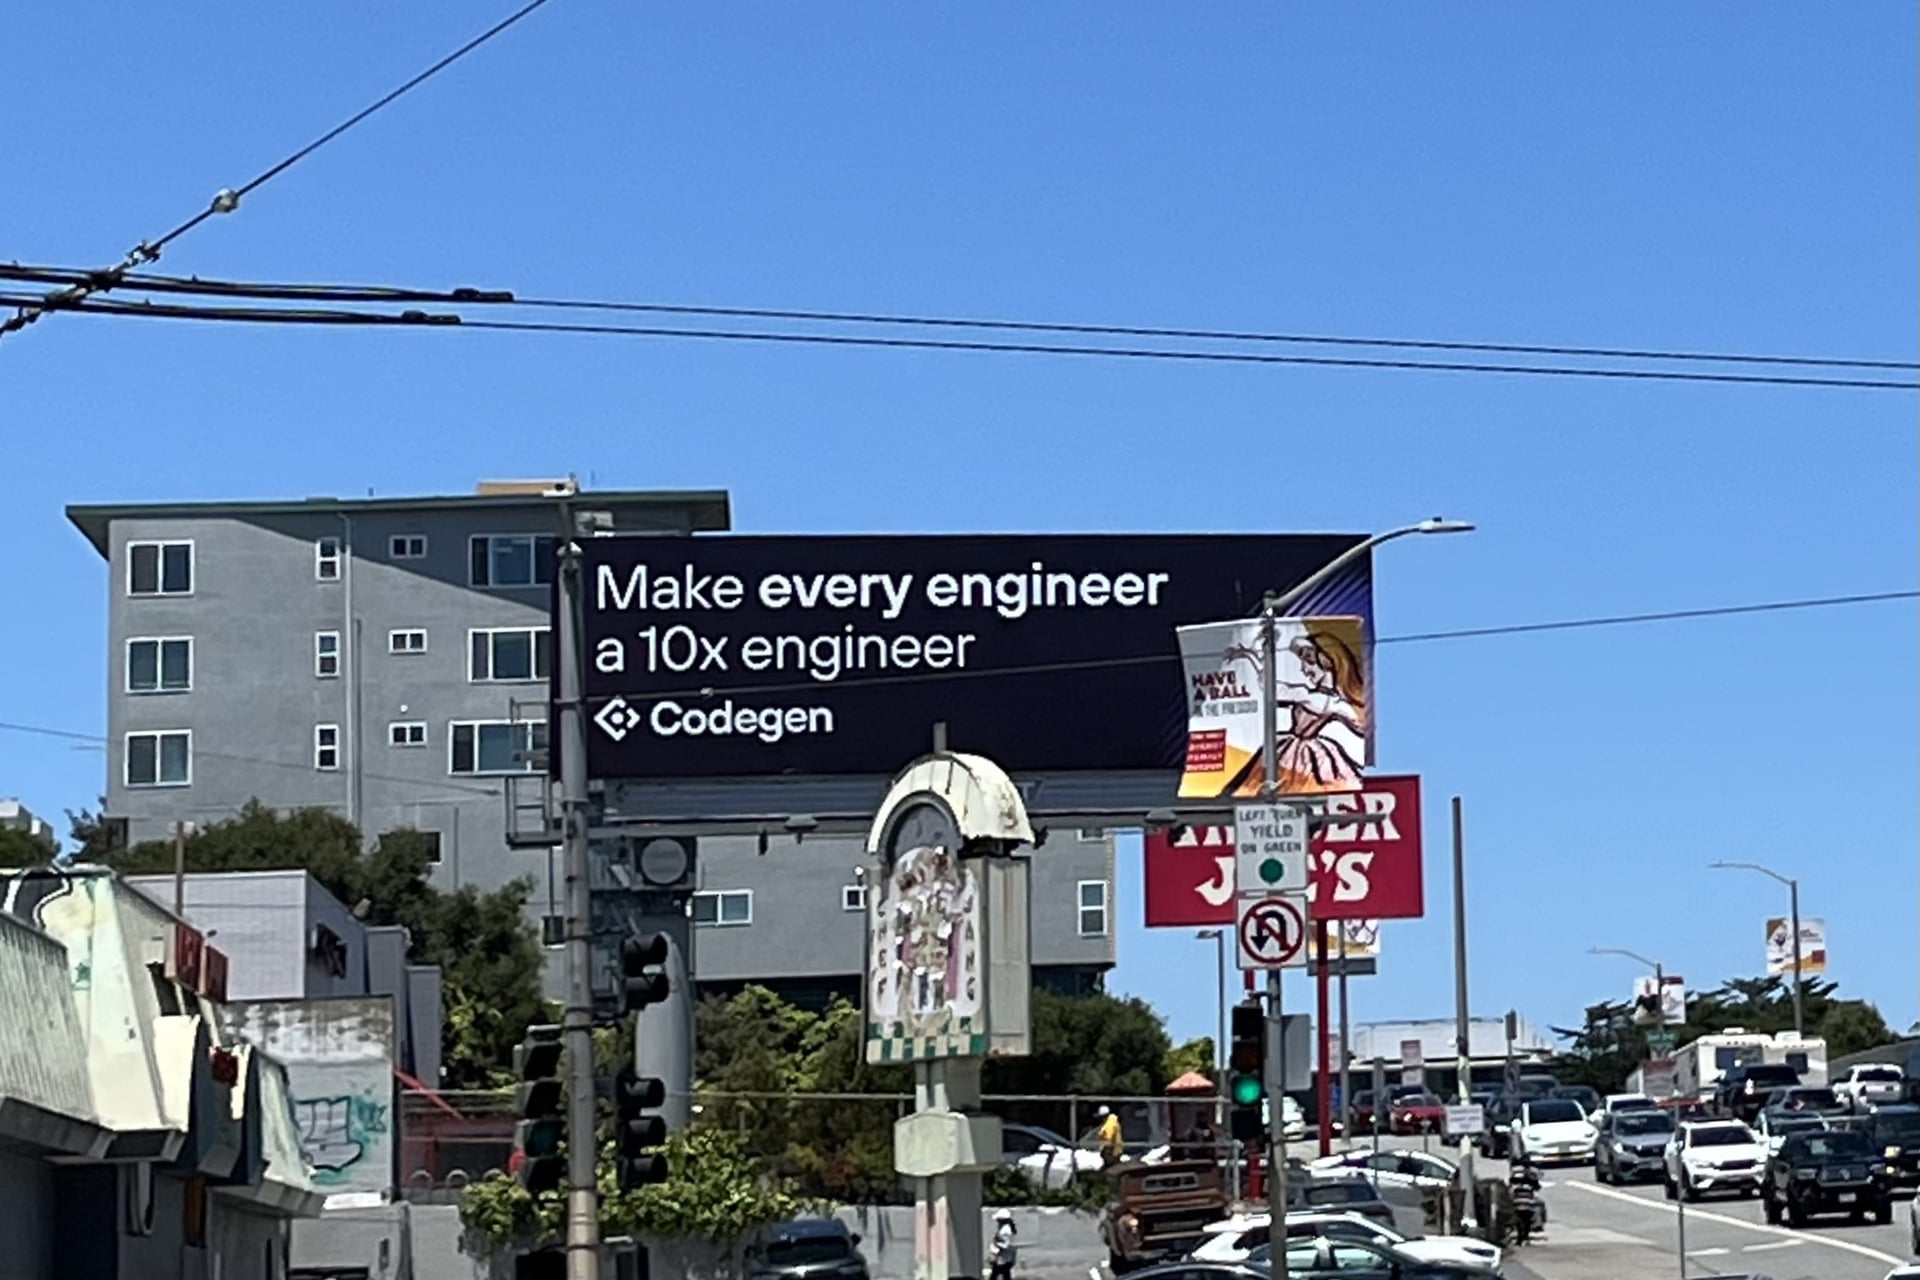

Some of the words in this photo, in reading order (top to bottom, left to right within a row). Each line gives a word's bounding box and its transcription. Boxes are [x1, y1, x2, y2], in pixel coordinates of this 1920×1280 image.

[597, 563, 744, 610] Make
[758, 573, 913, 618] every
[926, 561, 1169, 619] engineer
[595, 637, 624, 673] a
[638, 625, 729, 672] 10x
[741, 624, 976, 681] engineer
[1192, 670, 1237, 687] HAVE
[1194, 688, 1206, 701] A
[1209, 684, 1251, 700] BALL
[650, 699, 834, 743] Codegen
[1239, 809, 1266, 821] LEFT
[1270, 808, 1303, 822] TURN
[1250, 824, 1293, 838] YIELD
[1240, 843, 1257, 854] ON
[1264, 841, 1302, 853] GREEN
[1195, 850, 1374, 905] J'S
